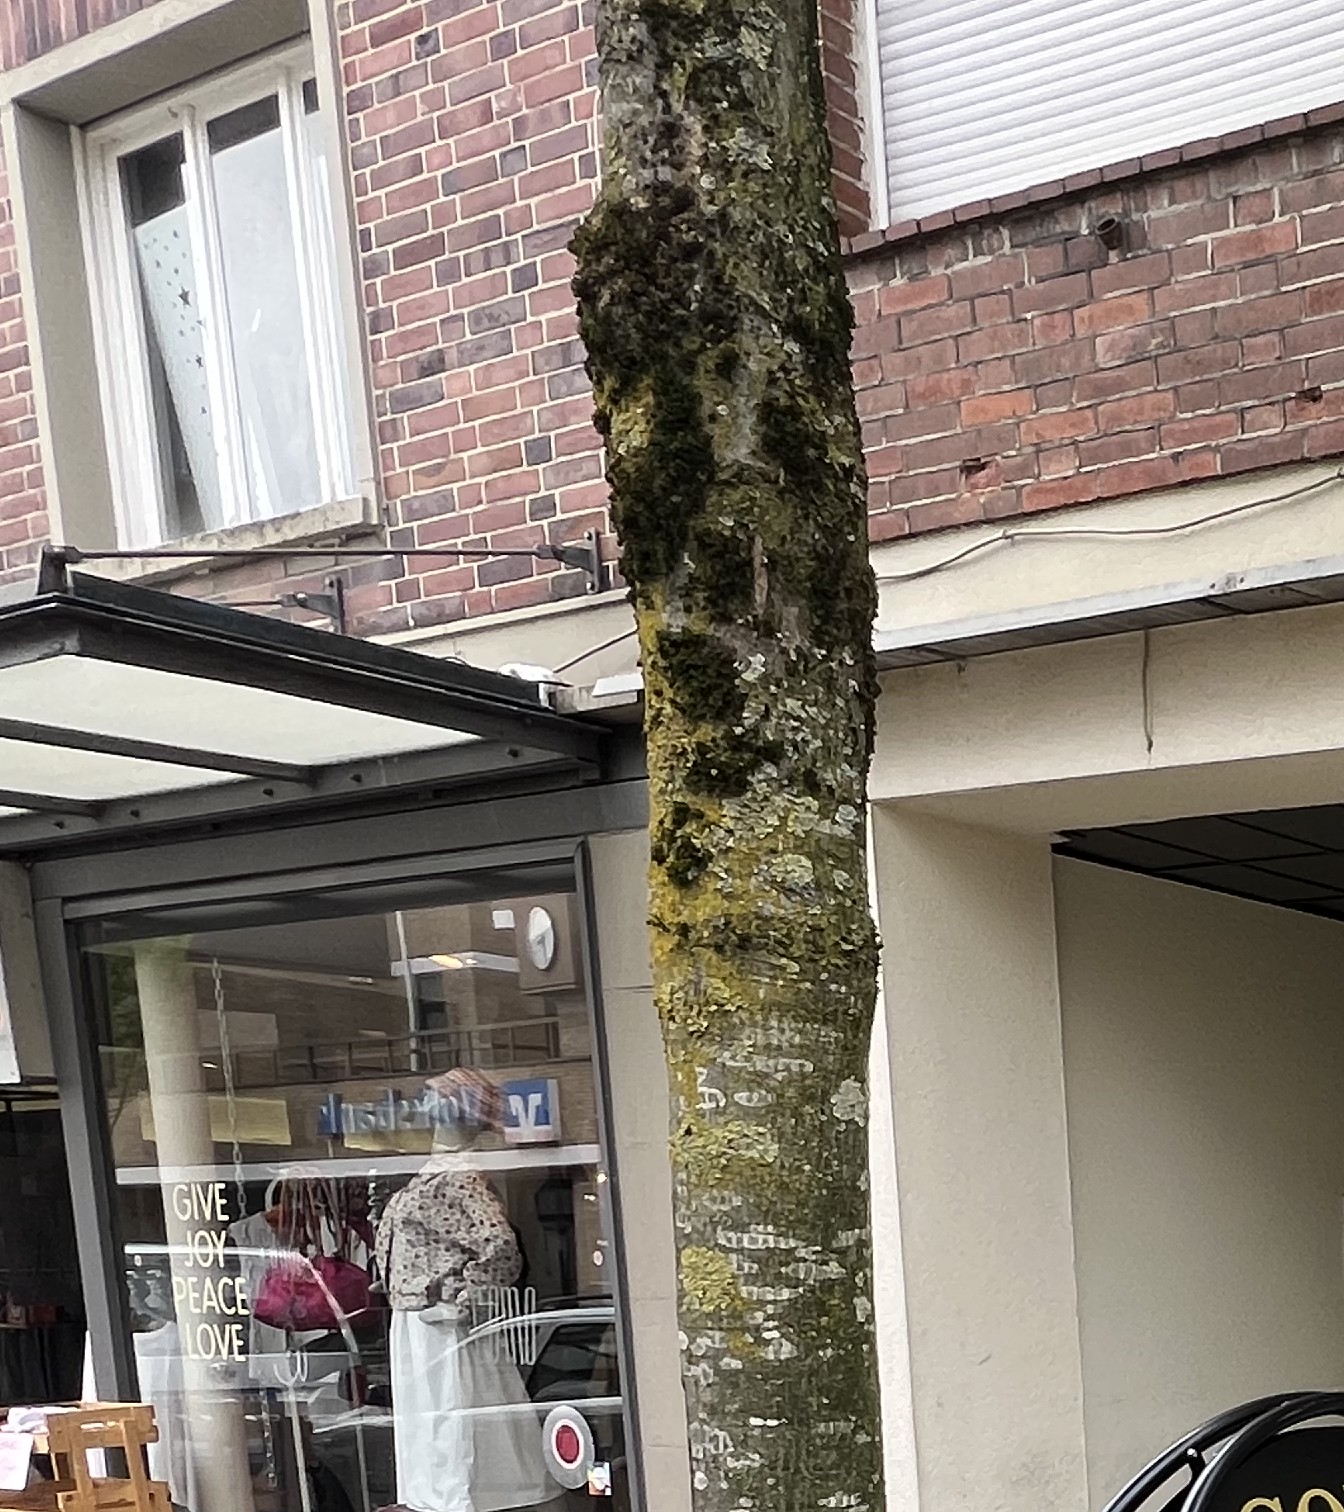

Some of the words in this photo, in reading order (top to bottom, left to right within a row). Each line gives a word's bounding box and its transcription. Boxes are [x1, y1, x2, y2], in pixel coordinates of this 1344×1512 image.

[172, 1182, 230, 1221] GIVE
[184, 1230, 226, 1268] JOY
[172, 1276, 250, 1316] PEACE
[185, 1323, 247, 1362] LOVE
